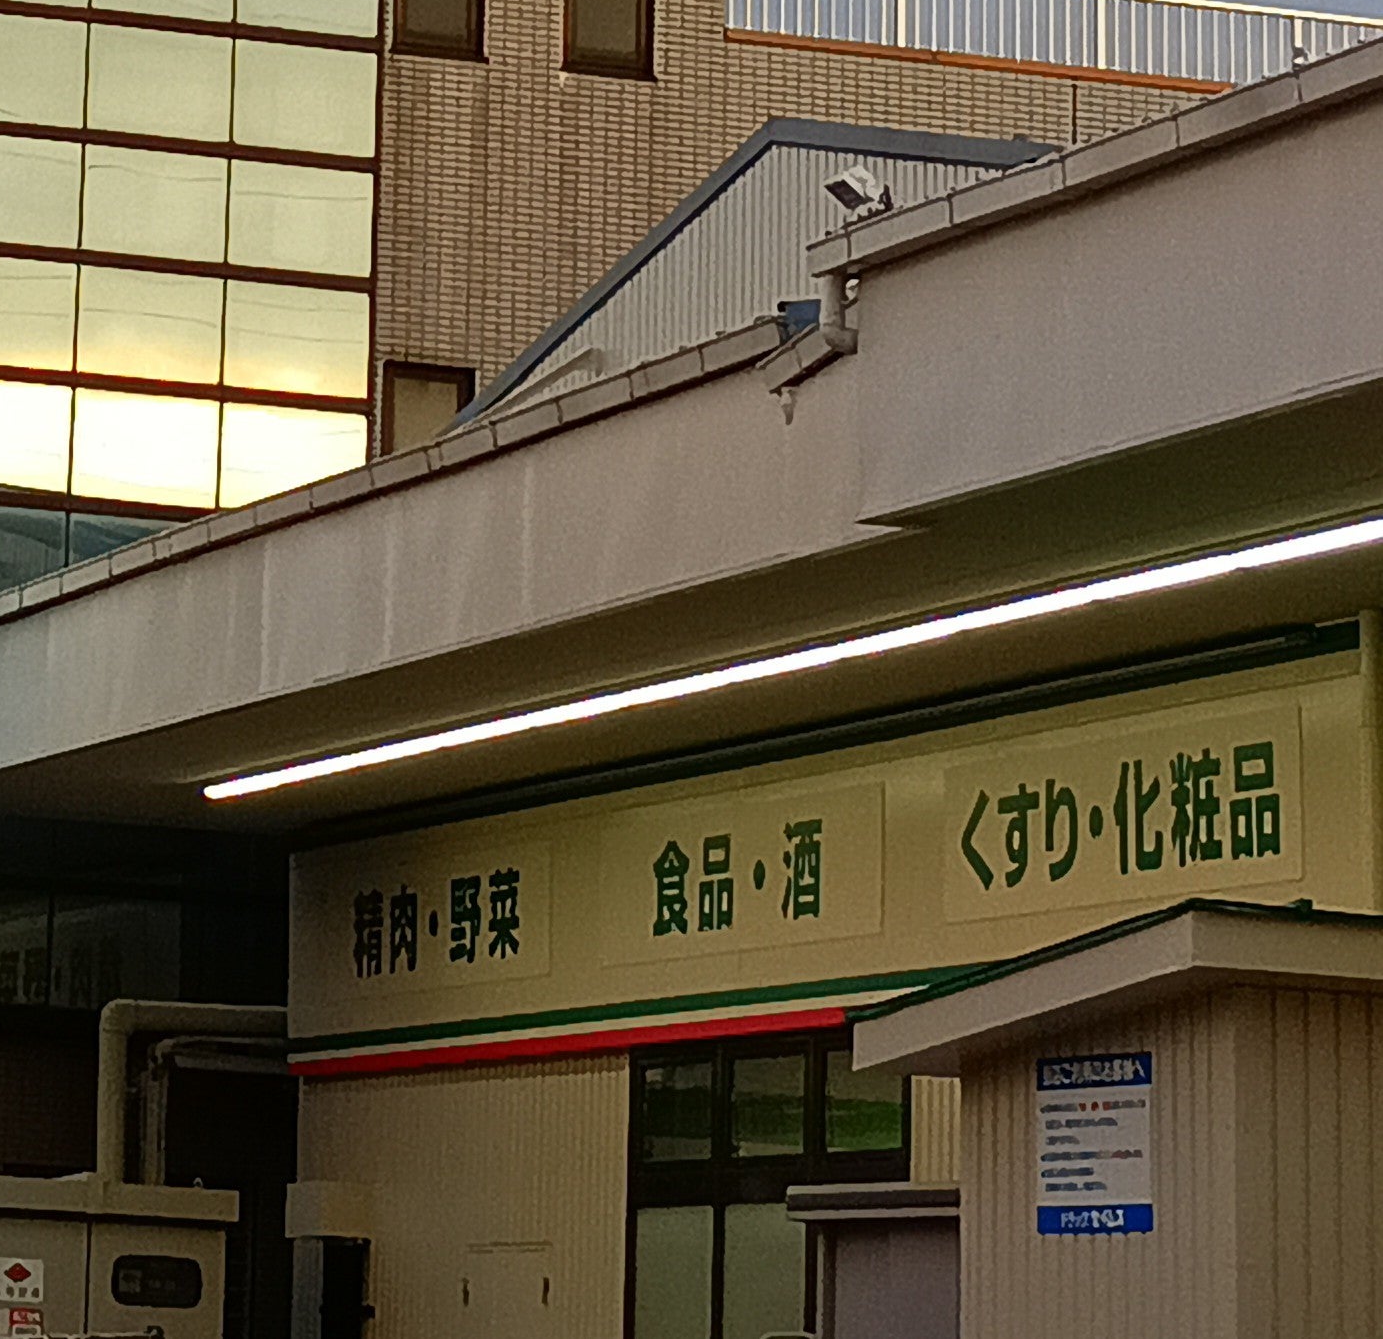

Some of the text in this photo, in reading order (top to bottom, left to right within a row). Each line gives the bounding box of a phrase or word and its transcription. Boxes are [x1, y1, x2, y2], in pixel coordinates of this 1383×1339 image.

[961, 741, 1283, 891] くすり・化粧品
[352, 866, 521, 979] 精肉・野菜
[652, 818, 823, 937] 食品・酒
